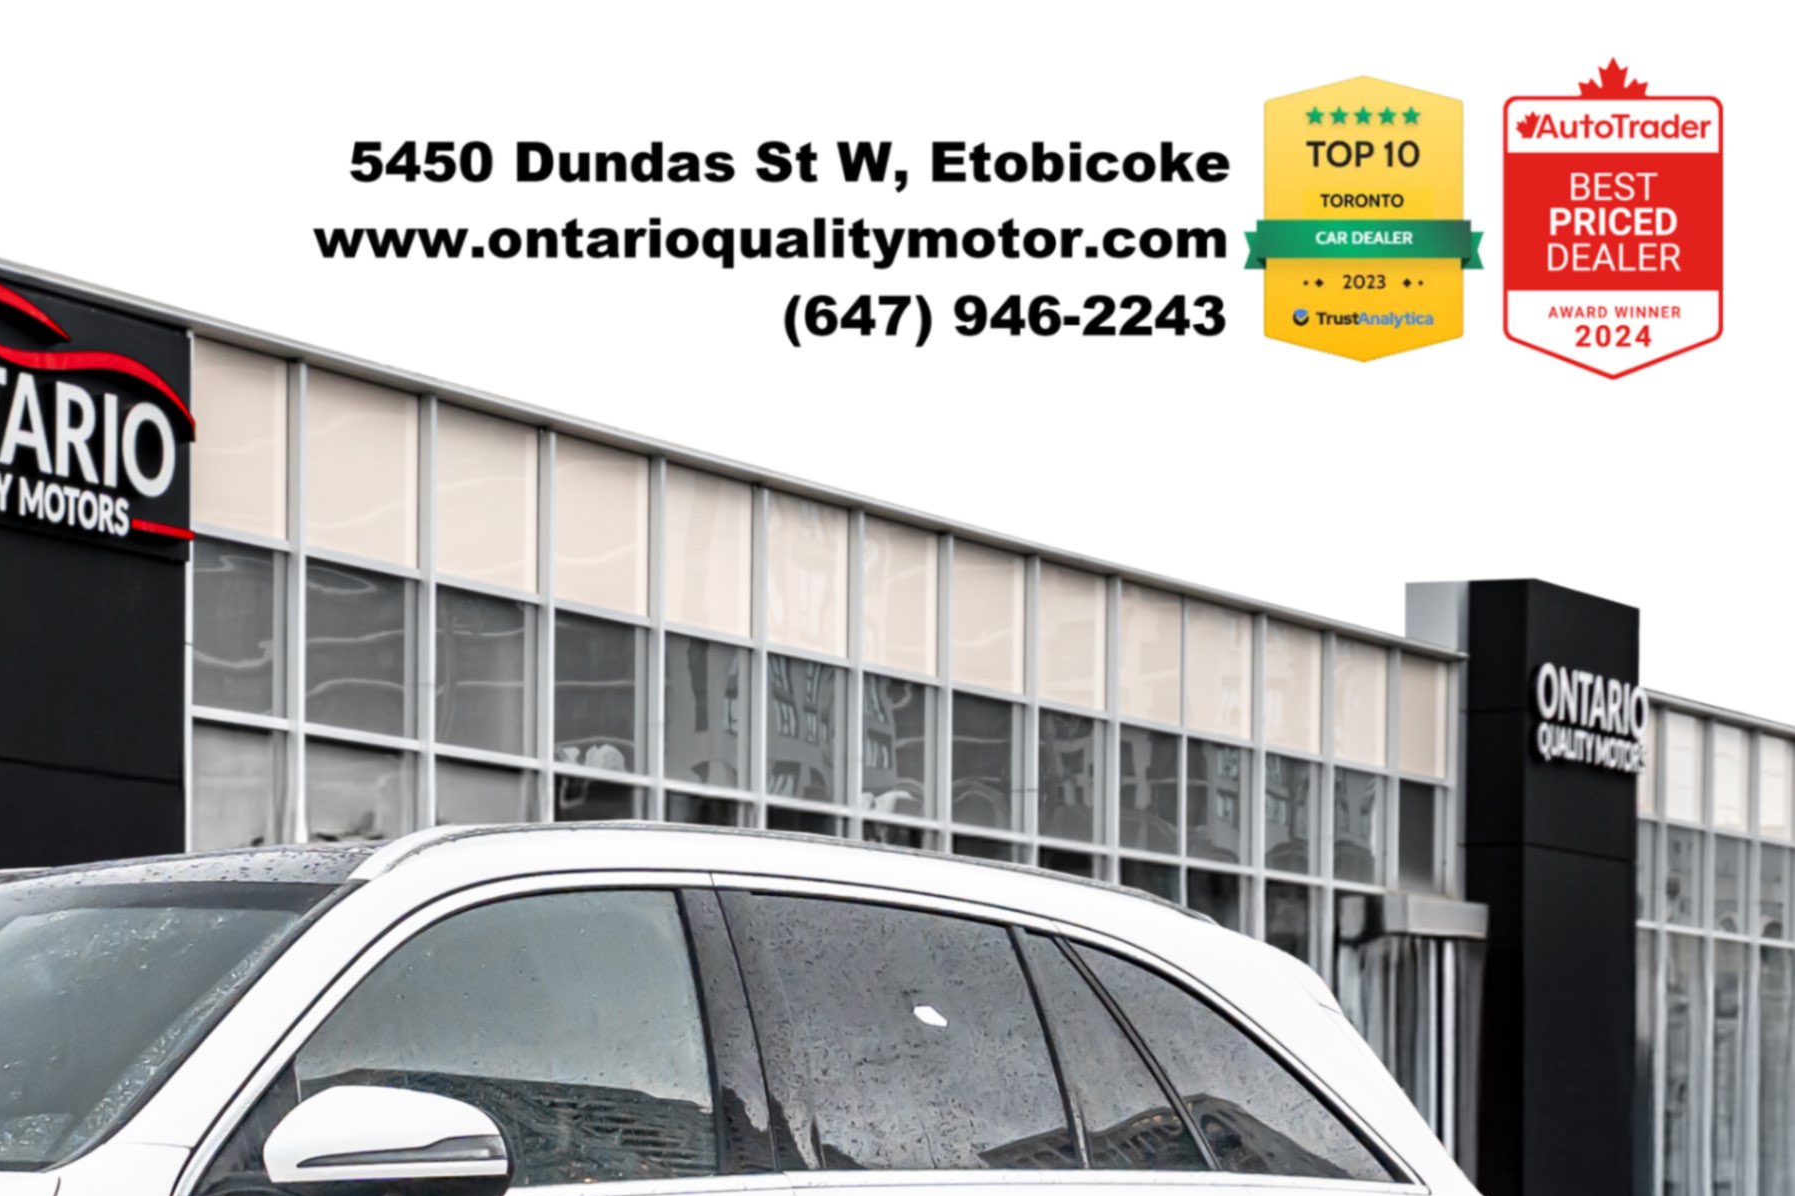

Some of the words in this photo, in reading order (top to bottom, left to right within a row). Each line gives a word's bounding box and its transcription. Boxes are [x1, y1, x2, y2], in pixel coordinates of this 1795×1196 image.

[18, 476, 131, 538] MOTORS
[1536, 662, 1649, 739] ONTARIO
[1537, 722, 1595, 762] QUALITY
